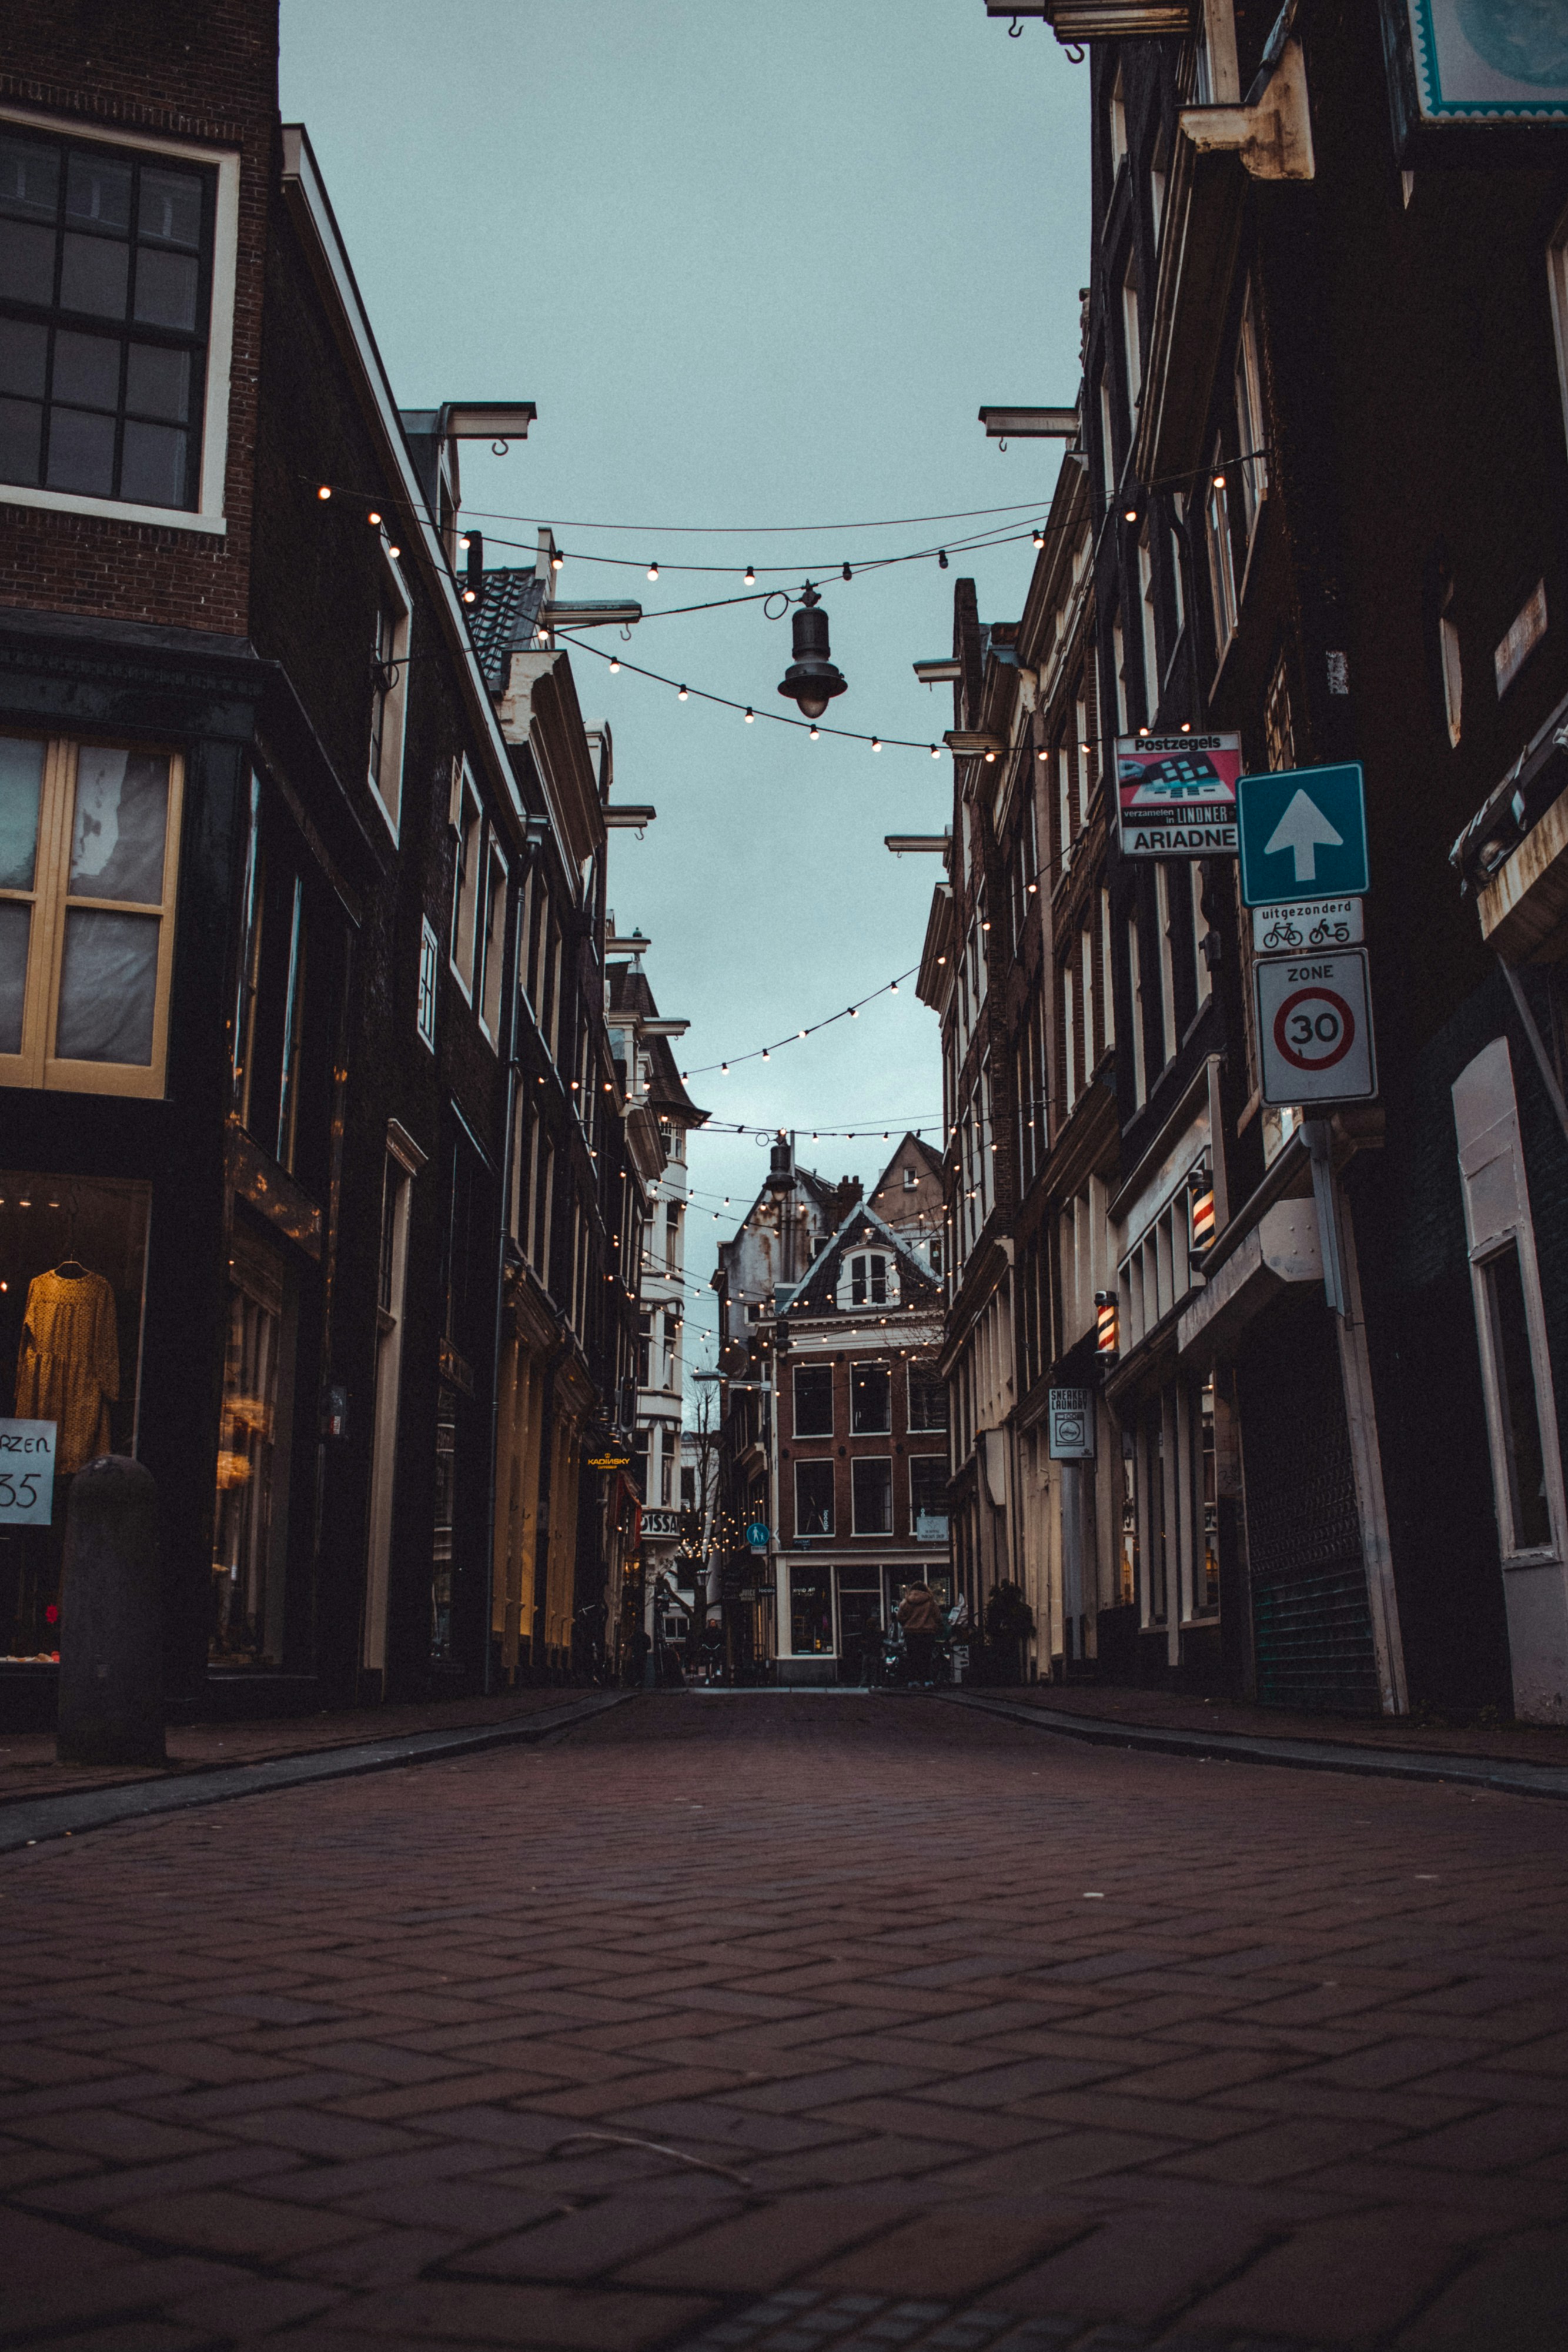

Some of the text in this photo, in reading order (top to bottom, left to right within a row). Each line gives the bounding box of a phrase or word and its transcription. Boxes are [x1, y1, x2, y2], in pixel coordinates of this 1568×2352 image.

[1135, 736, 1221, 751] Postzegels
[1124, 808, 1174, 818] verzamelen
[1177, 806, 1228, 824] LINDNER
[1134, 828, 1236, 850] ARIADNE
[1262, 901, 1352, 920] uitgezonderd
[1288, 965, 1333, 982] ZONE
[1290, 1013, 1339, 1044] 30
[1051, 1390, 1087, 1400] SNEAKER
[1051, 1400, 1087, 1410] LAUNDRY
